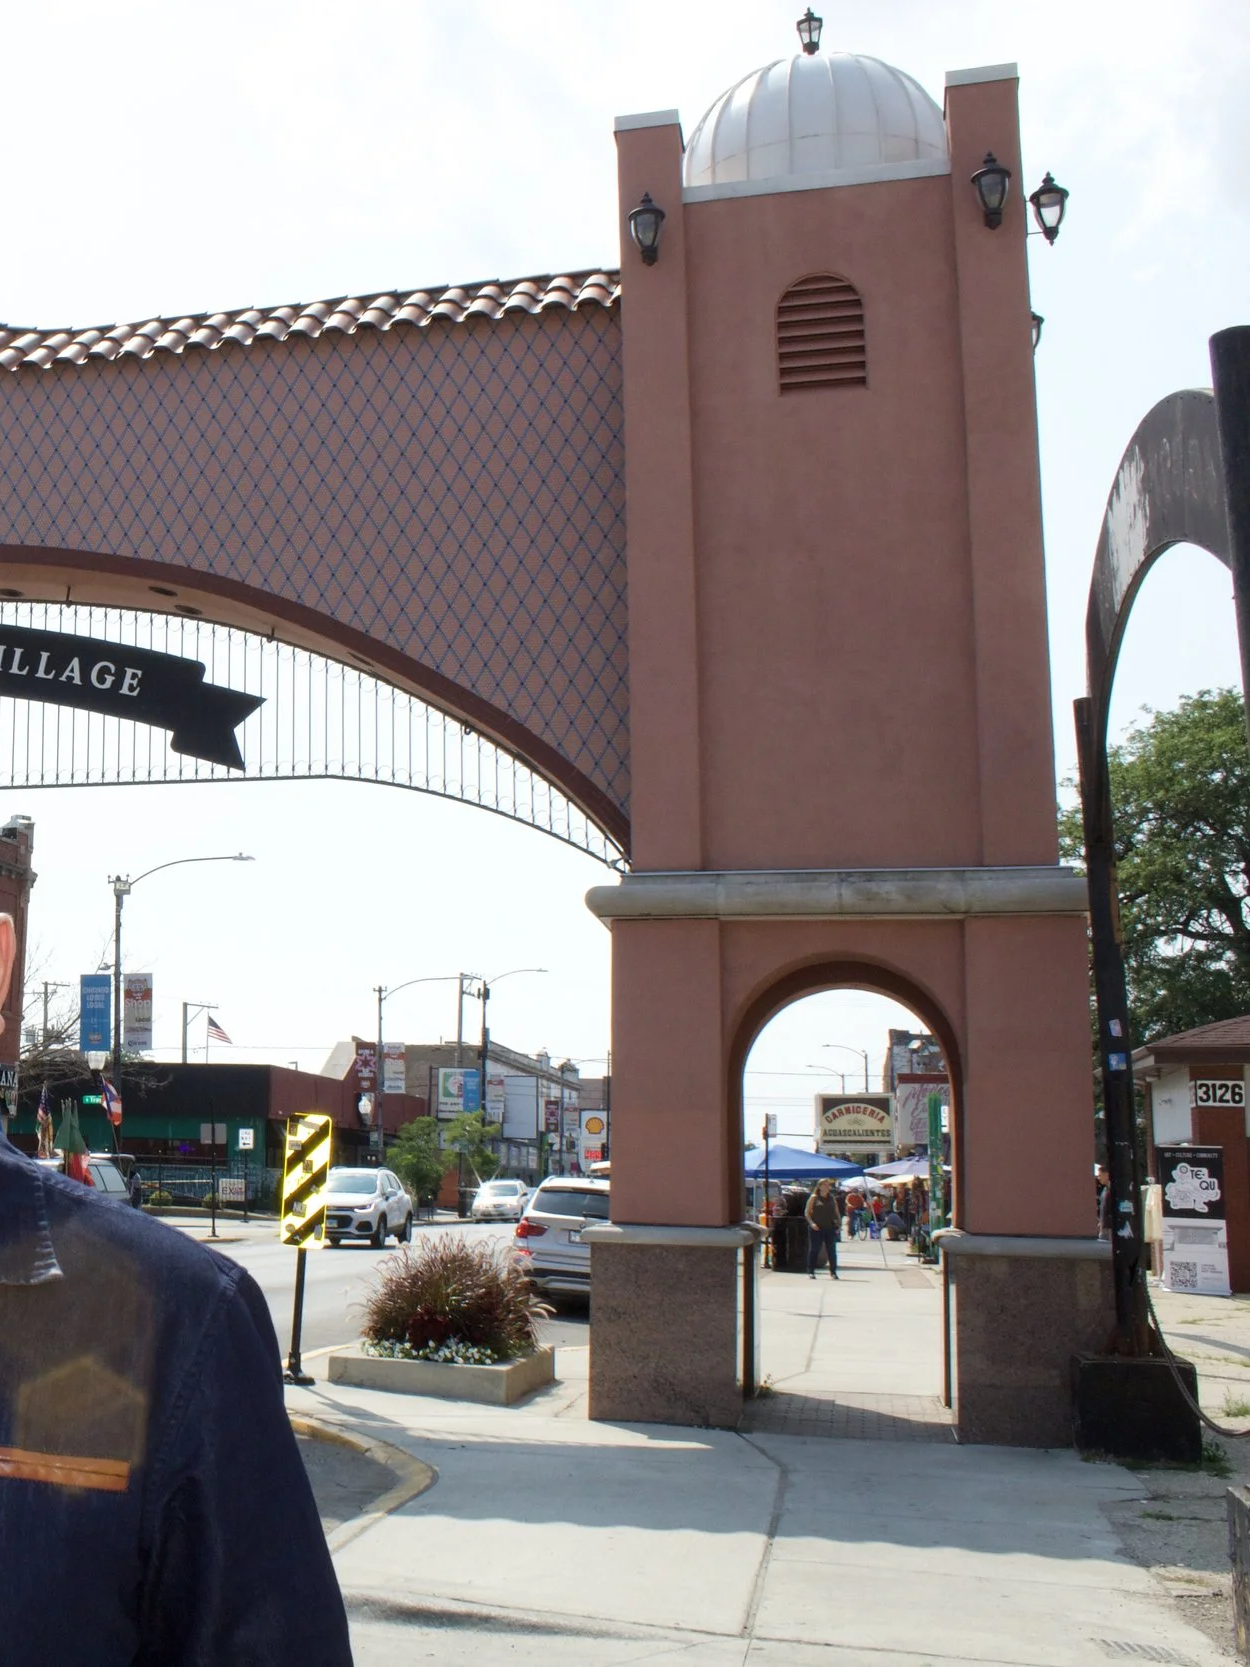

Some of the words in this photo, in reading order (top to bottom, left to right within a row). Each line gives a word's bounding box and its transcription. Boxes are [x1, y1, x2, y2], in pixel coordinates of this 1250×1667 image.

[1198, 1083, 1243, 1104] 3126
[824, 1105, 886, 1124] CARNICERIA
[1200, 1180, 1215, 1191] QU
